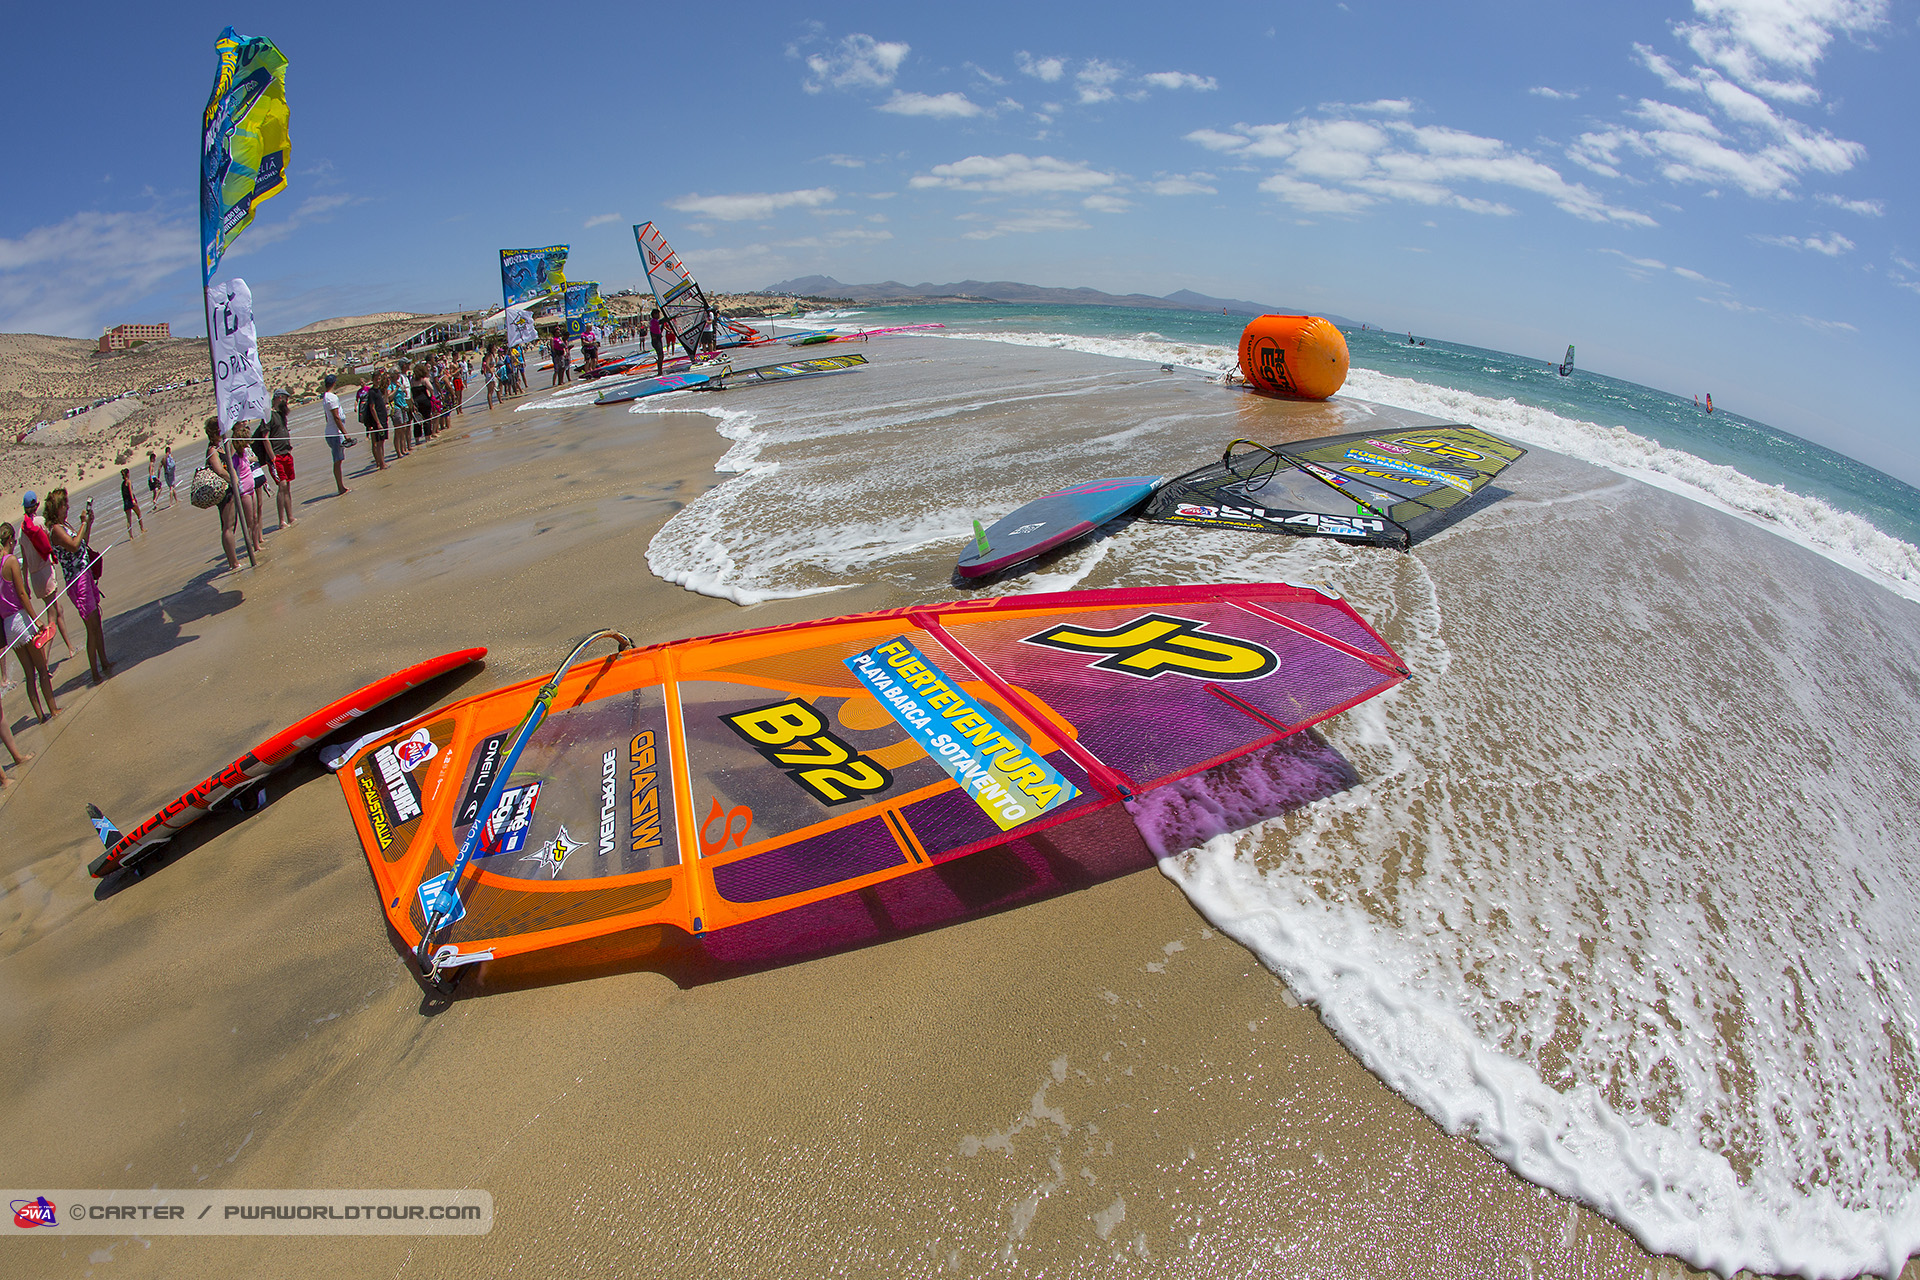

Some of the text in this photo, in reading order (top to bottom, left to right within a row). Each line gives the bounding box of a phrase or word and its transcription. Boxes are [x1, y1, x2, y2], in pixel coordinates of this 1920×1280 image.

[1347, 453, 1378, 465] PLAYA
[1377, 460, 1408, 472] BARCA
[1348, 448, 1470, 486] FUERTEVENTURA
[1398, 439, 1482, 460] JP
[1165, 515, 1265, 528] JP-AUSTRALIA
[1219, 504, 1384, 532] SLASH
[1033, 615, 1274, 678] JP
[853, 654, 894, 691] PLAYA
[883, 686, 932, 730] BARCA
[930, 734, 1026, 821] SOTAVENTO
[877, 641, 1063, 809] FUERTEVENTURA
[726, 699, 889, 804] B72
[374, 745, 422, 822] AGRITYRE
[511, 783, 540, 832] René
[361, 777, 394, 850] JP-AUSTRALIA
[552, 840, 567, 862] JP
